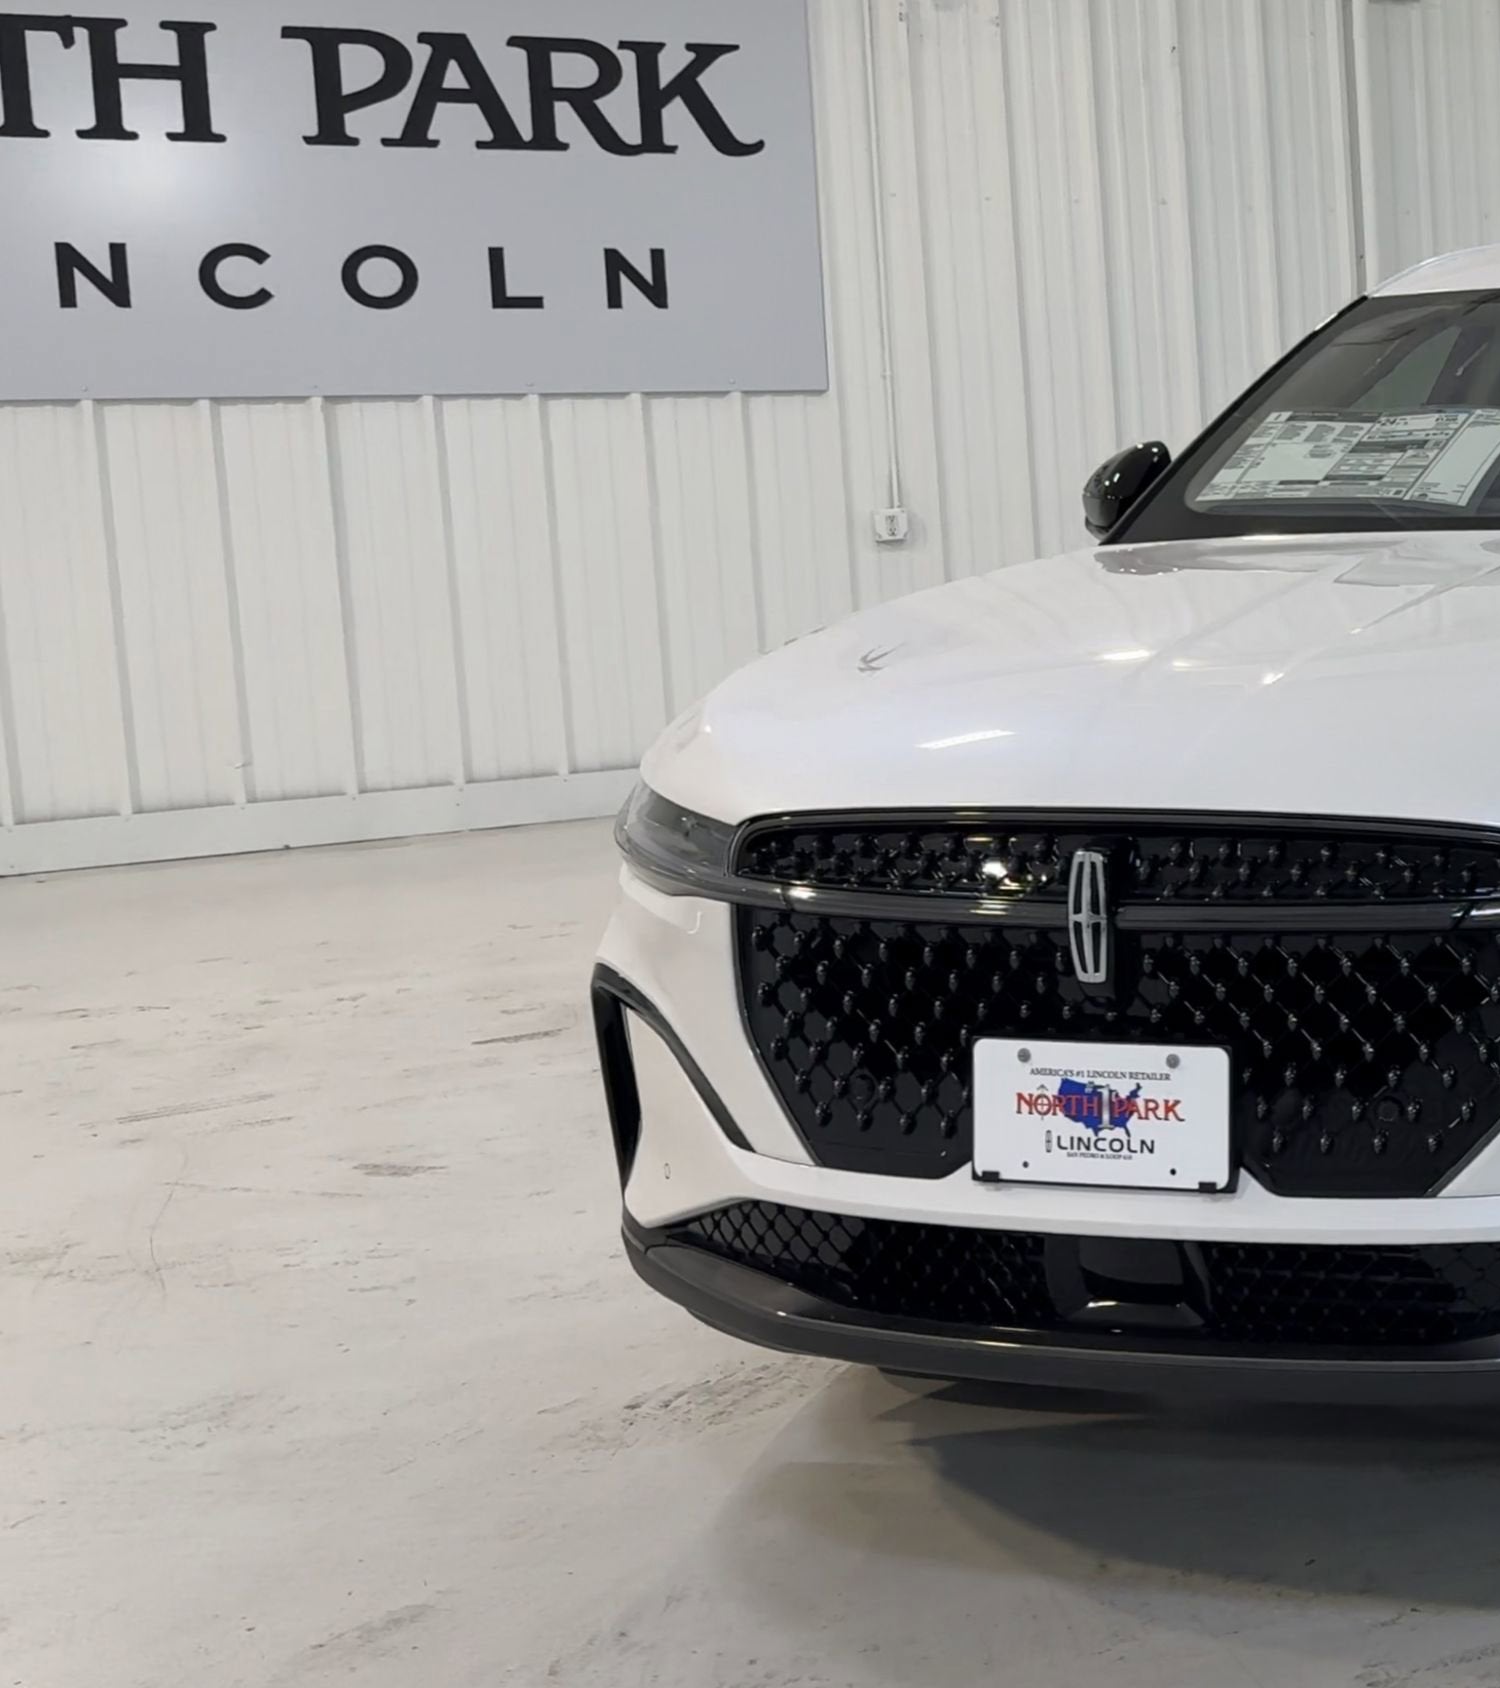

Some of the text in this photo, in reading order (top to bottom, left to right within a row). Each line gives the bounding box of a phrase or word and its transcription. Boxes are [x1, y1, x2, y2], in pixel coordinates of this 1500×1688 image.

[281, 26, 765, 157] PARK
[54, 242, 669, 310] NCOLN
[1087, 1070, 1127, 1080] LINCOLN
[1129, 1071, 1171, 1081] RETAILER
[1016, 1092, 1186, 1122] NORTH PARK
[1057, 1135, 1155, 1154] LINCOLN
